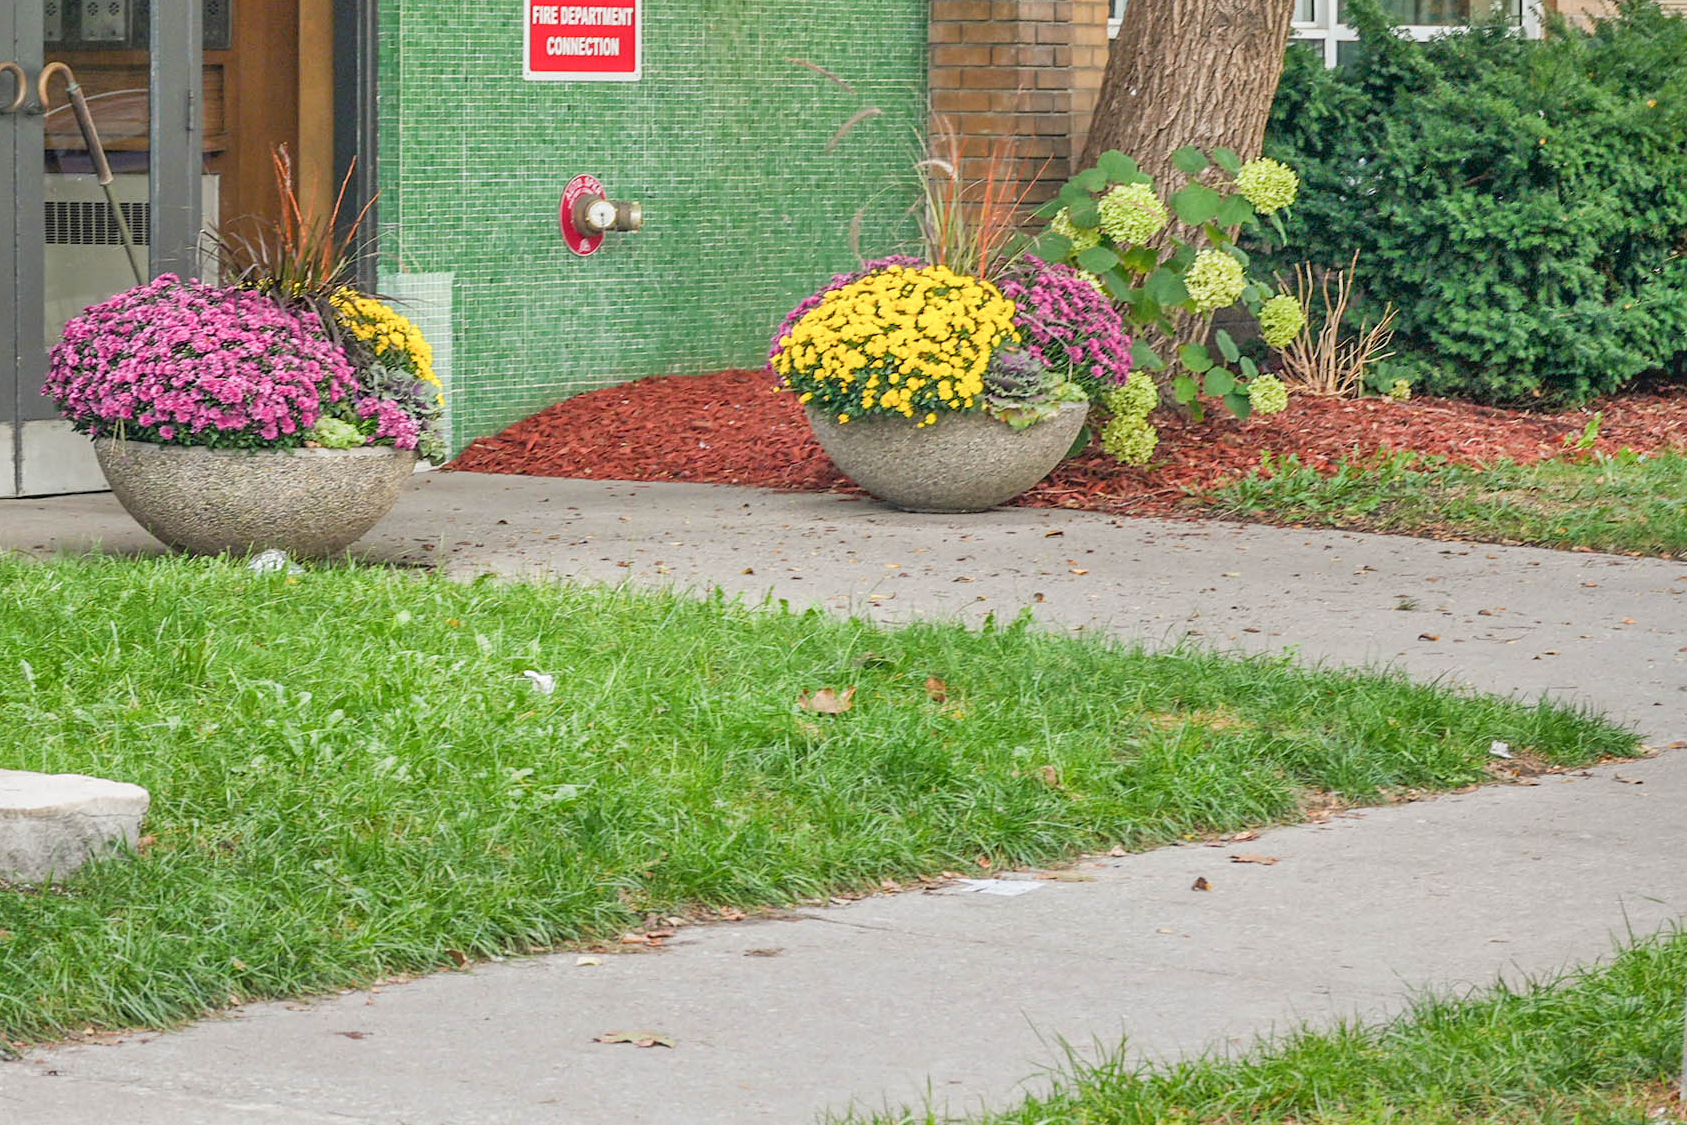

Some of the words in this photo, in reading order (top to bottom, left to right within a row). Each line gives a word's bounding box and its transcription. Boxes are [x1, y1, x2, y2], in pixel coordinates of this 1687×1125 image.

[532, 5, 559, 24] FIRE
[560, 6, 634, 26] DEPARTMENT
[546, 36, 620, 56] CONNECTION
